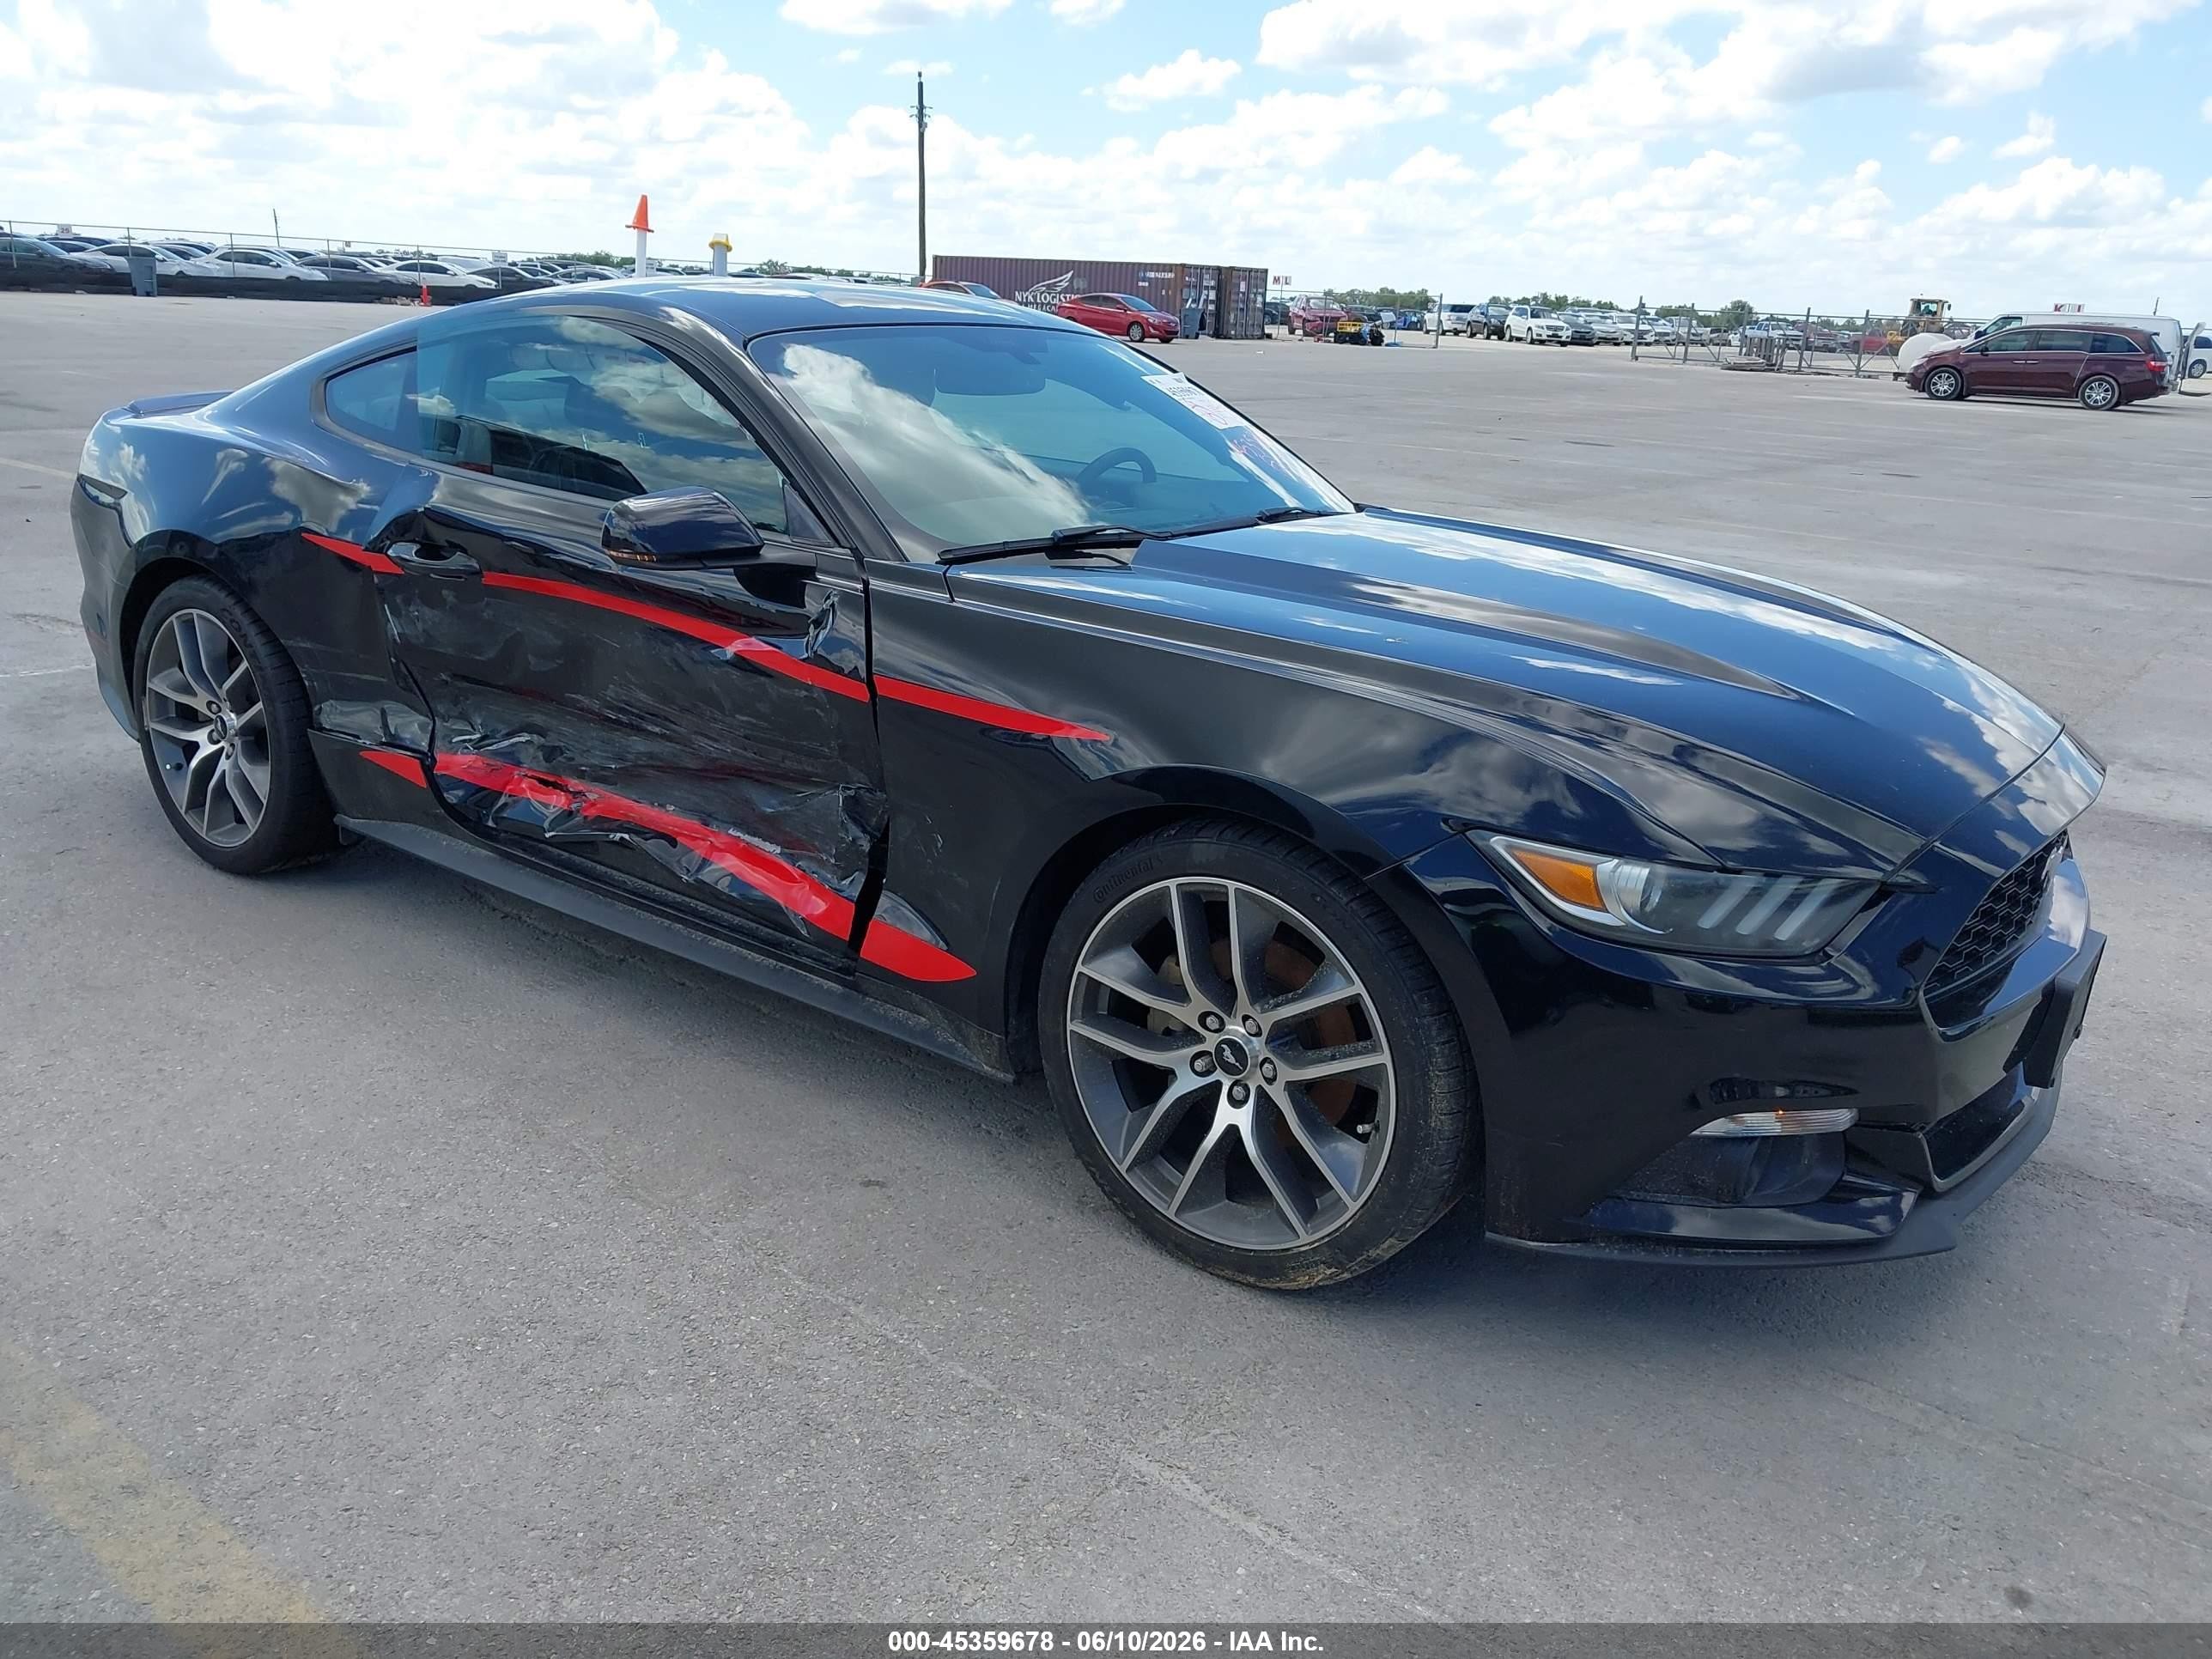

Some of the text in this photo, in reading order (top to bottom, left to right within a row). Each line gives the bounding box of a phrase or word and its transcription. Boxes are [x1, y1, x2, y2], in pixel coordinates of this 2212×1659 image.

[1273, 276, 1280, 285] M
[1015, 291, 1036, 303] NYK
[1093, 858, 1154, 903] Continental
